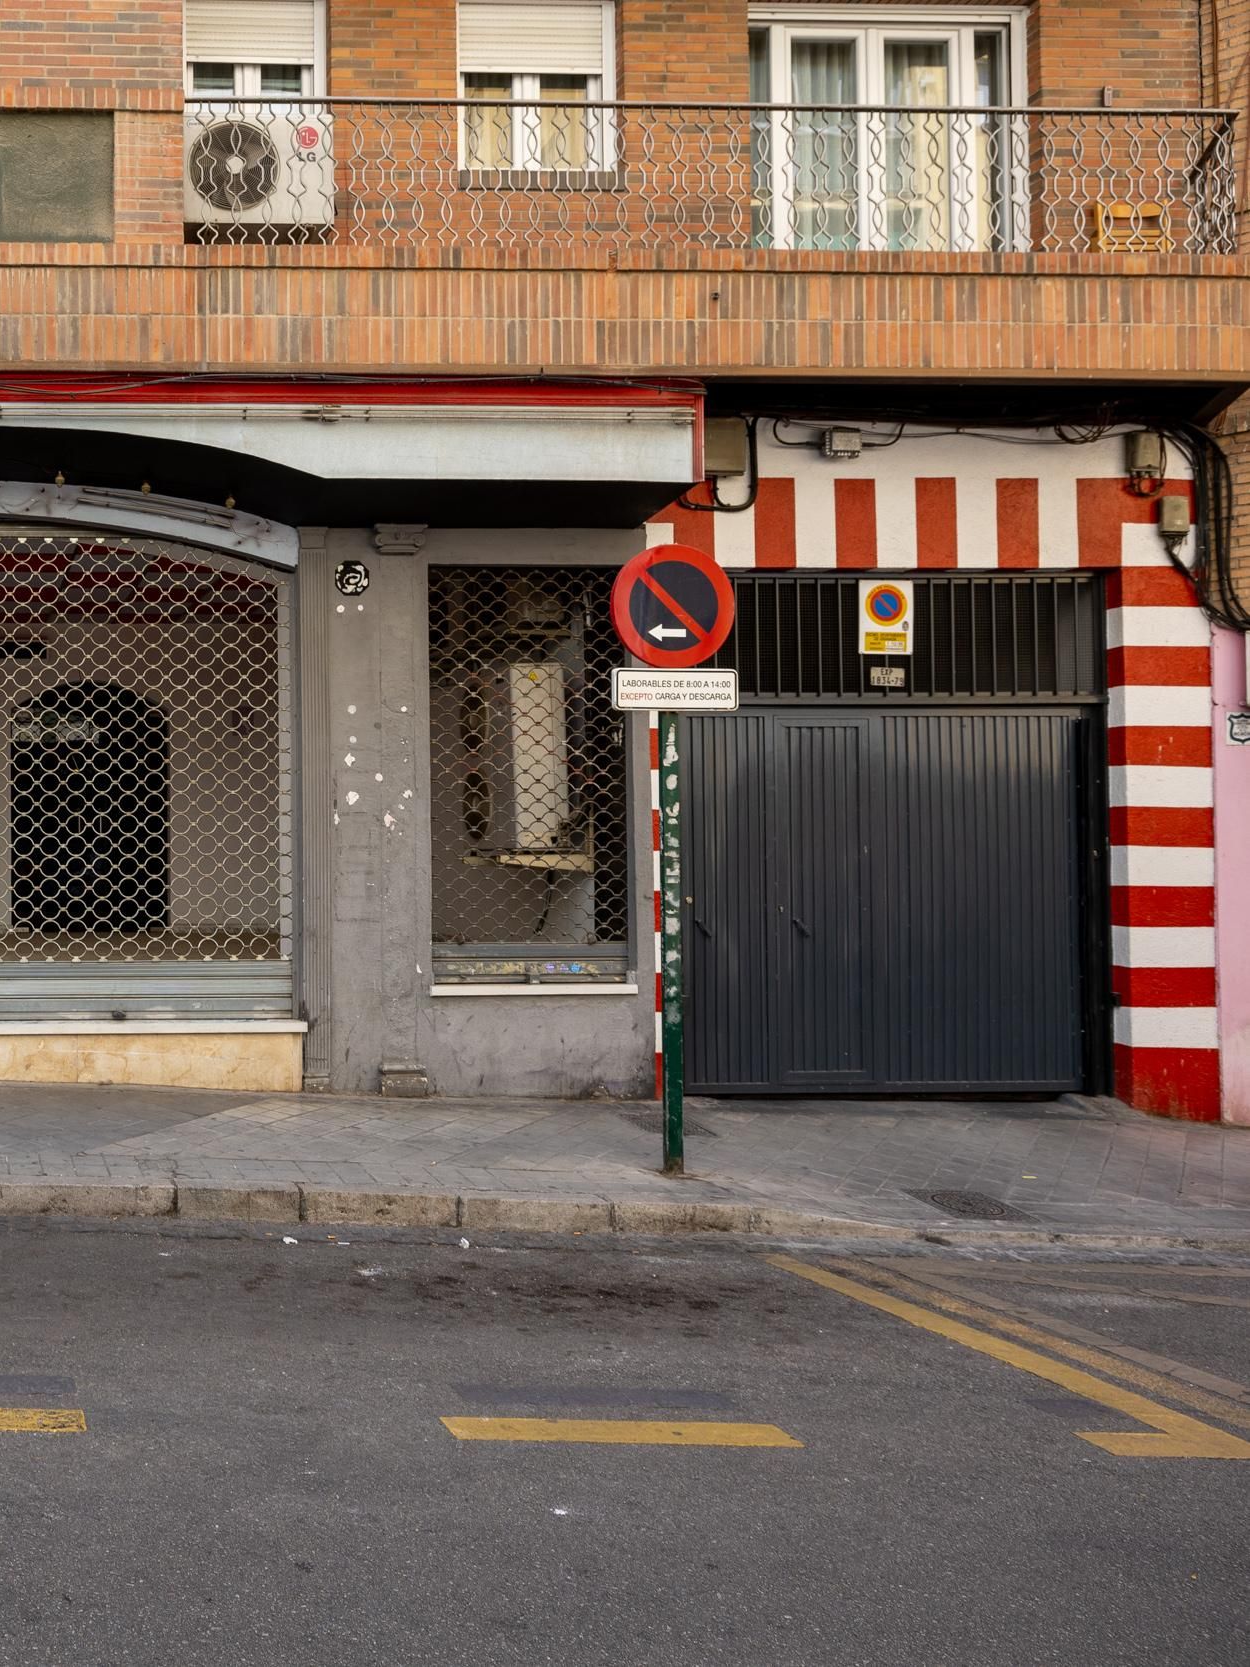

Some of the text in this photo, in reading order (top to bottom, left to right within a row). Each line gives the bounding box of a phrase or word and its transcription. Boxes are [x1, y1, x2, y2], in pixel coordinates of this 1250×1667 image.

[673, 680, 685, 688] DE
[620, 692, 653, 700] EXCEPTO
[689, 693, 732, 701] DESCARGA
